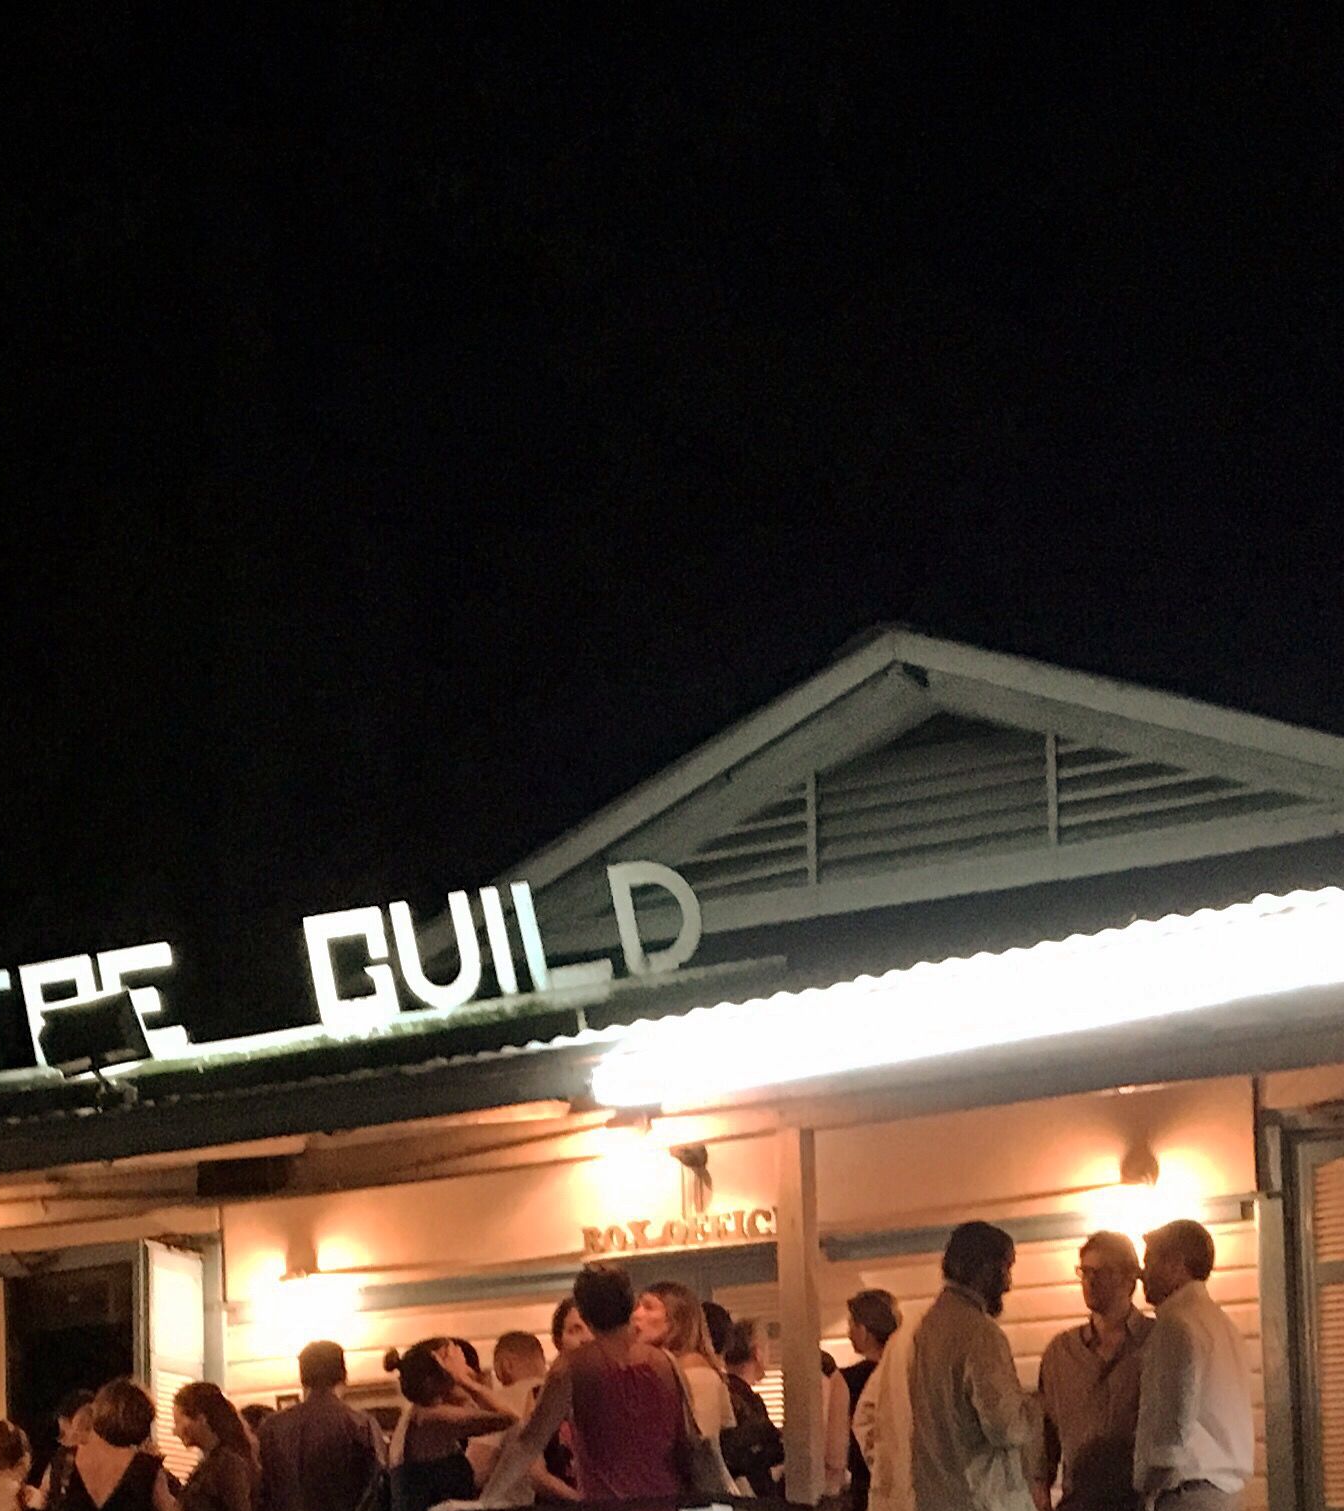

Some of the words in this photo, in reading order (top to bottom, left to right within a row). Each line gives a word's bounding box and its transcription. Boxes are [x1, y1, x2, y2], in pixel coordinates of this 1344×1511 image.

[303, 860, 702, 1038] GUILD
[582, 1220, 650, 1252] BOX
[661, 1207, 777, 1246] OFFIC
